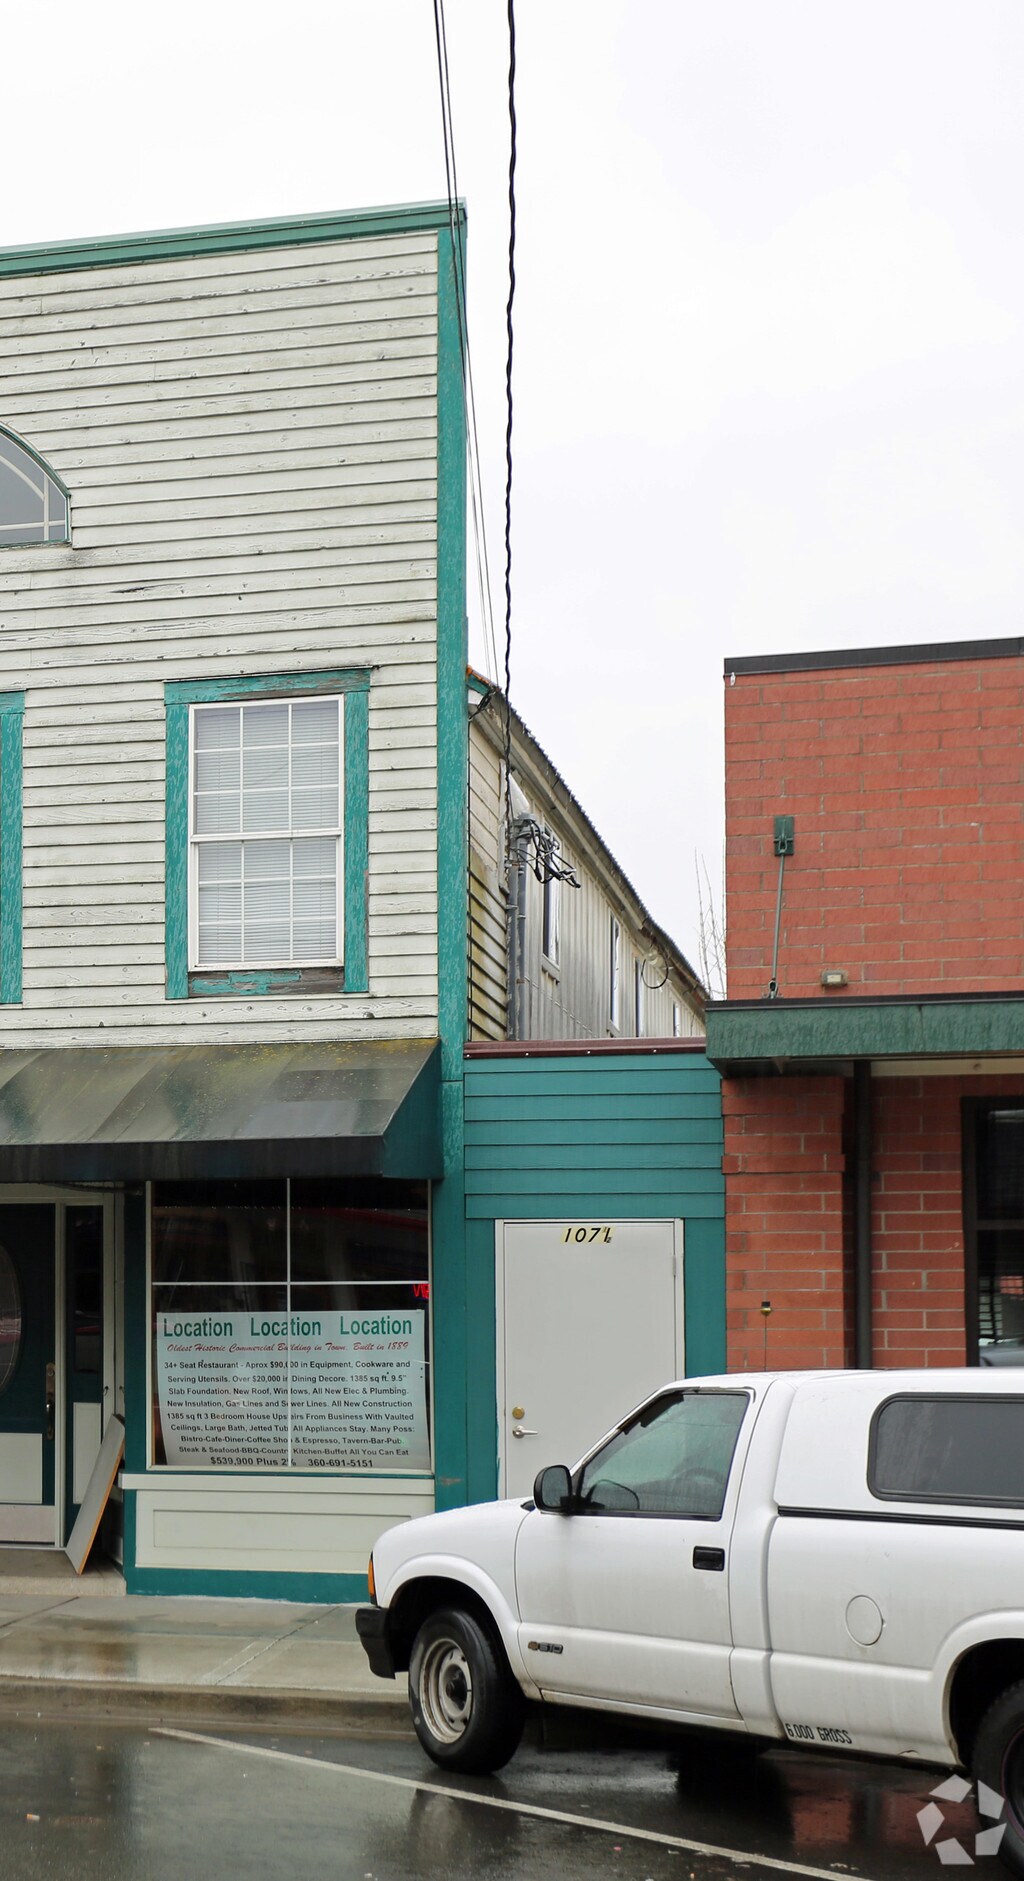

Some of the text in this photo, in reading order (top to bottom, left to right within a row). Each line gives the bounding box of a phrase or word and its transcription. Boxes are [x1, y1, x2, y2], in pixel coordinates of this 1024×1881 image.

[163, 1315, 412, 1337] Location Location Location
[166, 1343, 193, 1352] Oldest
[194, 1343, 226, 1352] Historic
[228, 1343, 275, 1353] Commercial
[353, 1341, 375, 1351] Built
[179, 1361, 196, 1369] Seat
[198, 1361, 239, 1369] Restaurant
[245, 1361, 268, 1370] Aprox
[310, 1361, 353, 1370] Equipment,
[396, 1360, 411, 1368] and
[167, 1375, 196, 1384] Serving
[232, 1375, 250, 1383] Over
[252, 1375, 281, 1384] $20,000
[292, 1375, 317, 1384] Dining
[370, 1376, 379, 1384] sq
[168, 1387, 185, 1395] Slab
[233, 1387, 250, 1395] New
[273, 1387, 310, 1396] Winows,
[312, 1387, 323, 1395] All
[343, 1387, 360, 1395] Elec
[362, 1387, 367, 1395] &
[369, 1387, 409, 1396] Plumbing.
[167, 1400, 183, 1408] New
[184, 1400, 224, 1408] Insulation,
[242, 1400, 263, 1408] Lines
[265, 1400, 279, 1408] and
[362, 1400, 412, 1408] Construction
[272, 1413, 304, 1421] Upsairs
[170, 1424, 203, 1432] Ceilings,
[204, 1424, 226, 1433] Large
[227, 1424, 248, 1432] Bath,
[249, 1424, 272, 1432] Jetted
[305, 1425, 347, 1433] Appliances
[349, 1425, 368, 1434] Stay.
[370, 1425, 391, 1434] Many
[294, 1436, 300, 1444] &
[302, 1437, 340, 1445] Espresso,
[293, 1448, 348, 1456] Kitchen-Buffet
[378, 1448, 394, 1456] Can
[210, 1456, 254, 1466] $539,900
[256, 1457, 279, 1466] Plus
[308, 1458, 373, 1467] 360-691-5151
[816, 1726, 853, 1744] GROSS
